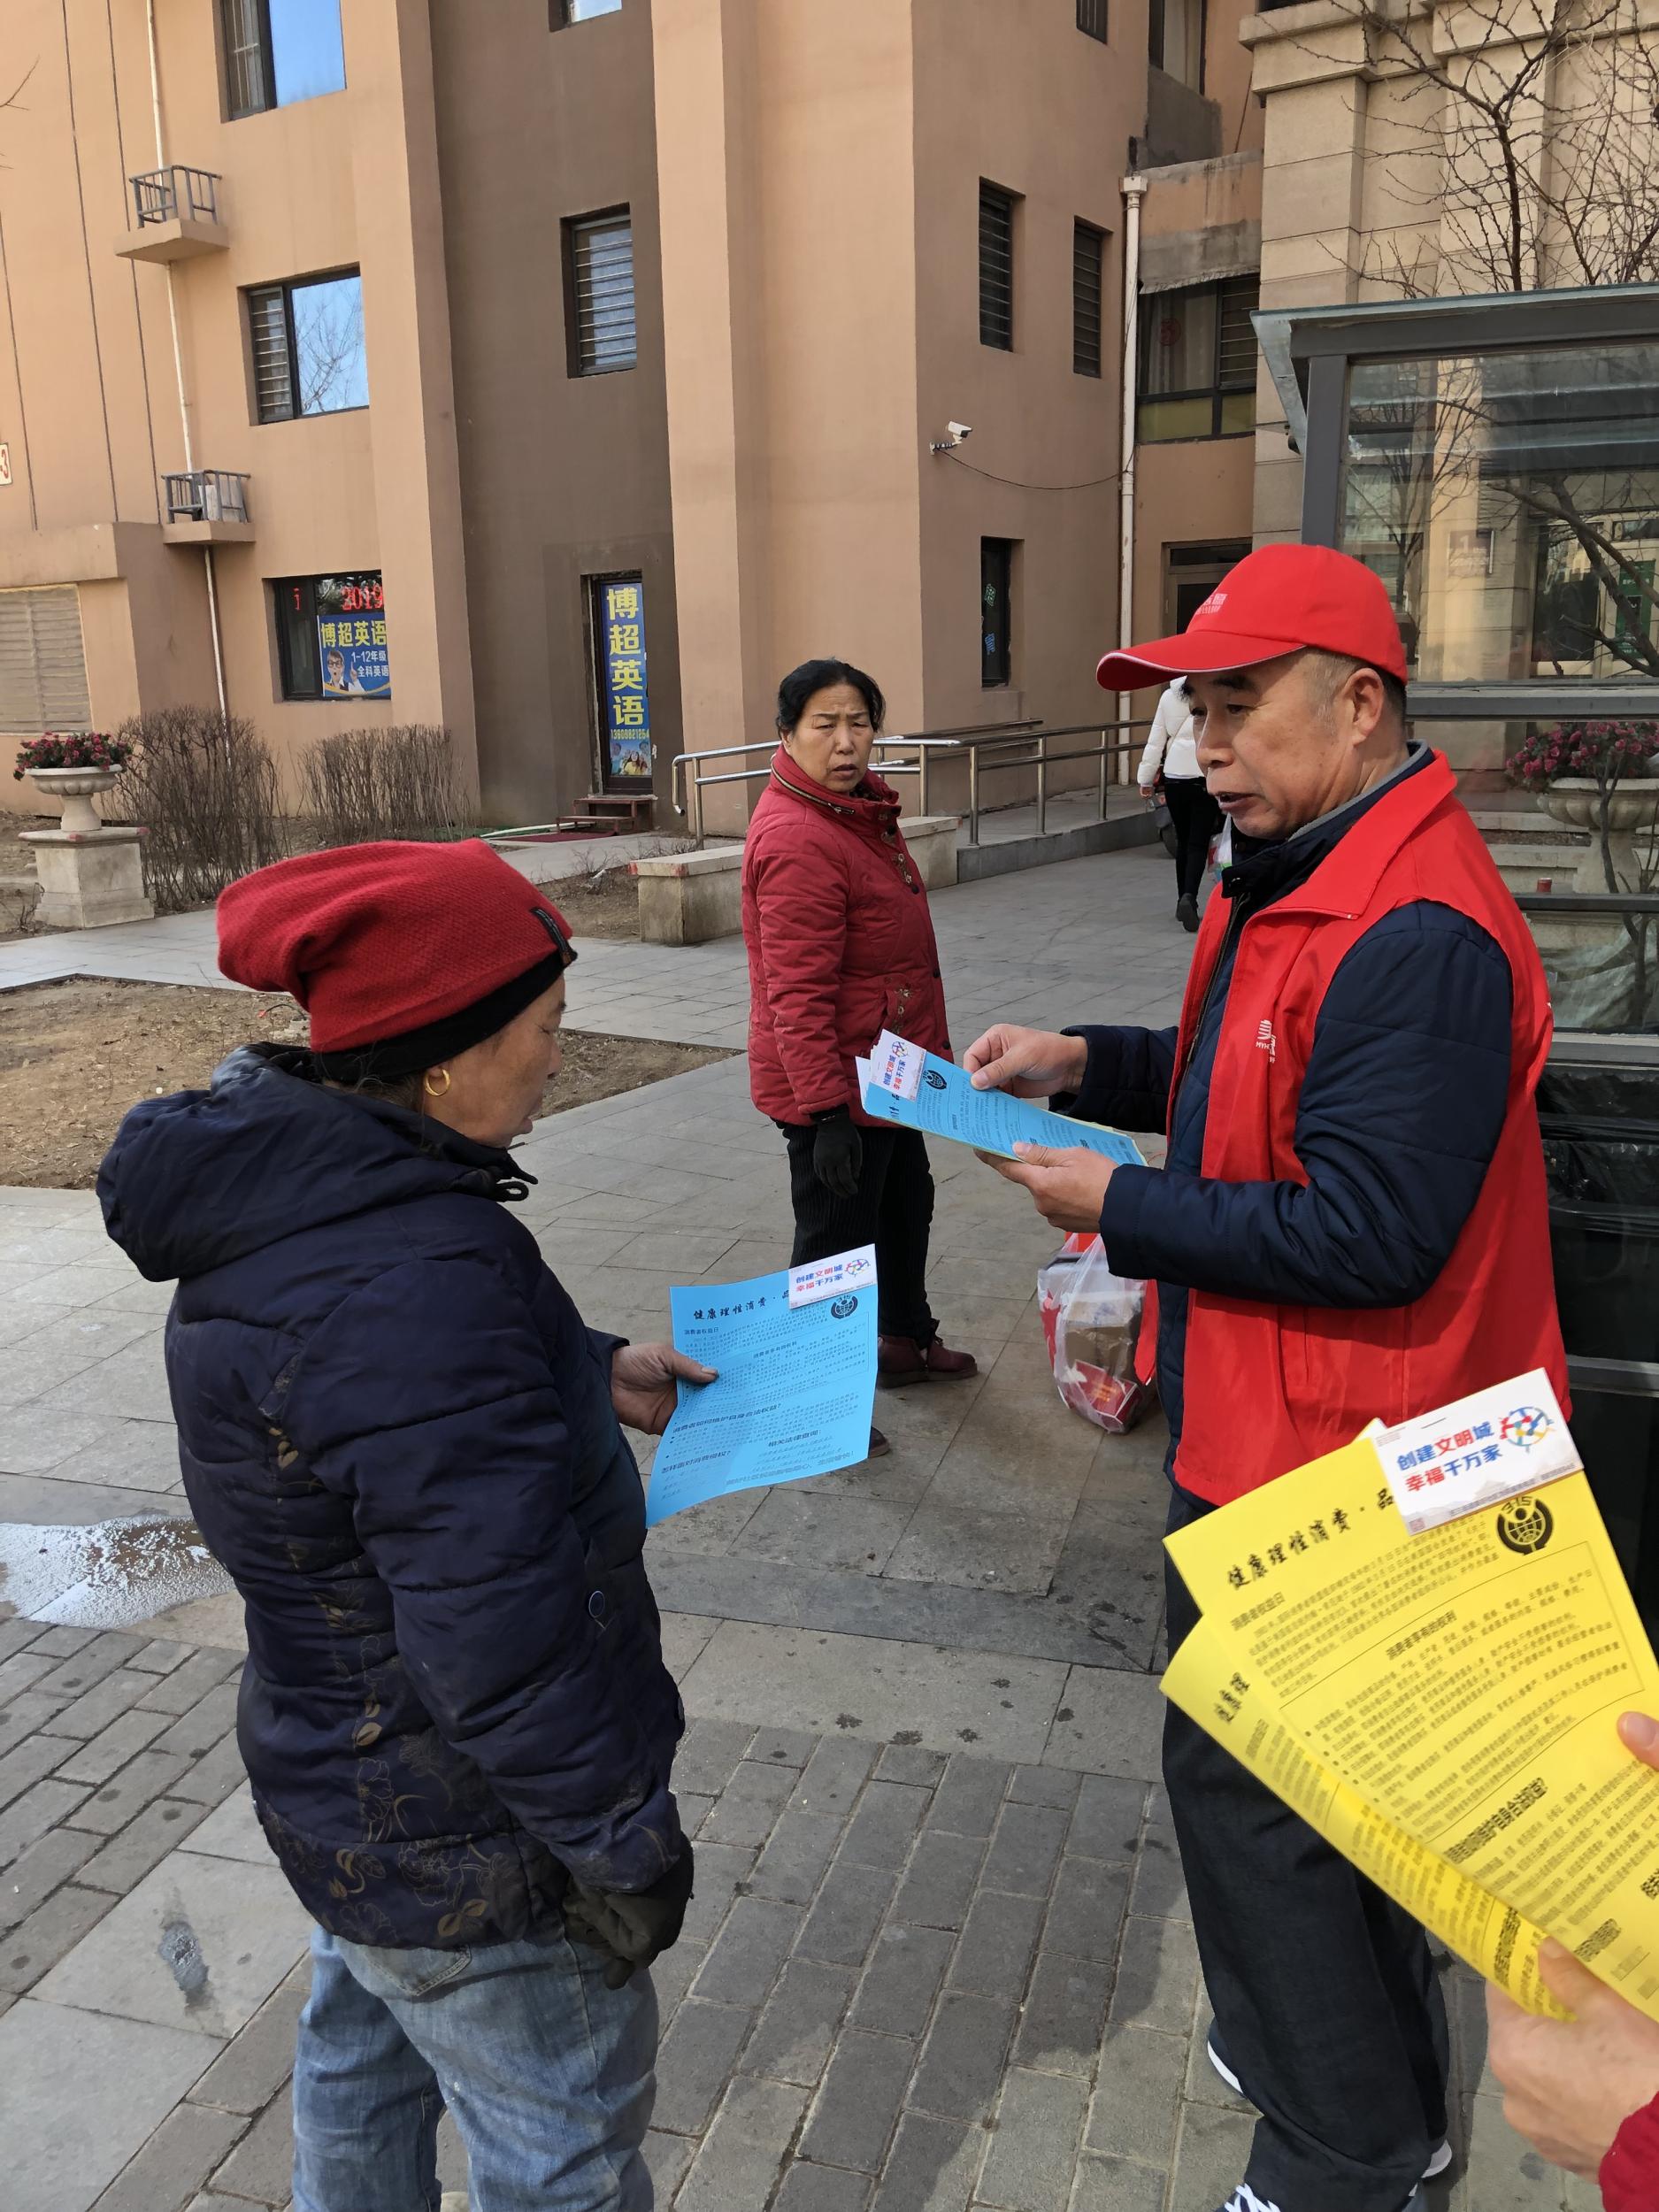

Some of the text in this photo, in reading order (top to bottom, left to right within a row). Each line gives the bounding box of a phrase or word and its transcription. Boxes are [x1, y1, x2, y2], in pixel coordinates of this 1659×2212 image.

[320, 620, 387, 648] 博超英语
[351, 650, 387, 663] 1-12年级
[607, 588, 644, 726] 博超英语
[357, 665, 389, 678] 全科英语
[795, 1263, 843, 1284] 创建文明城
[795, 1273, 843, 1293] 幸福千万家
[1396, 1421, 1495, 1472] 创建文明城
[1404, 1444, 1503, 1493] 幸福千万家
